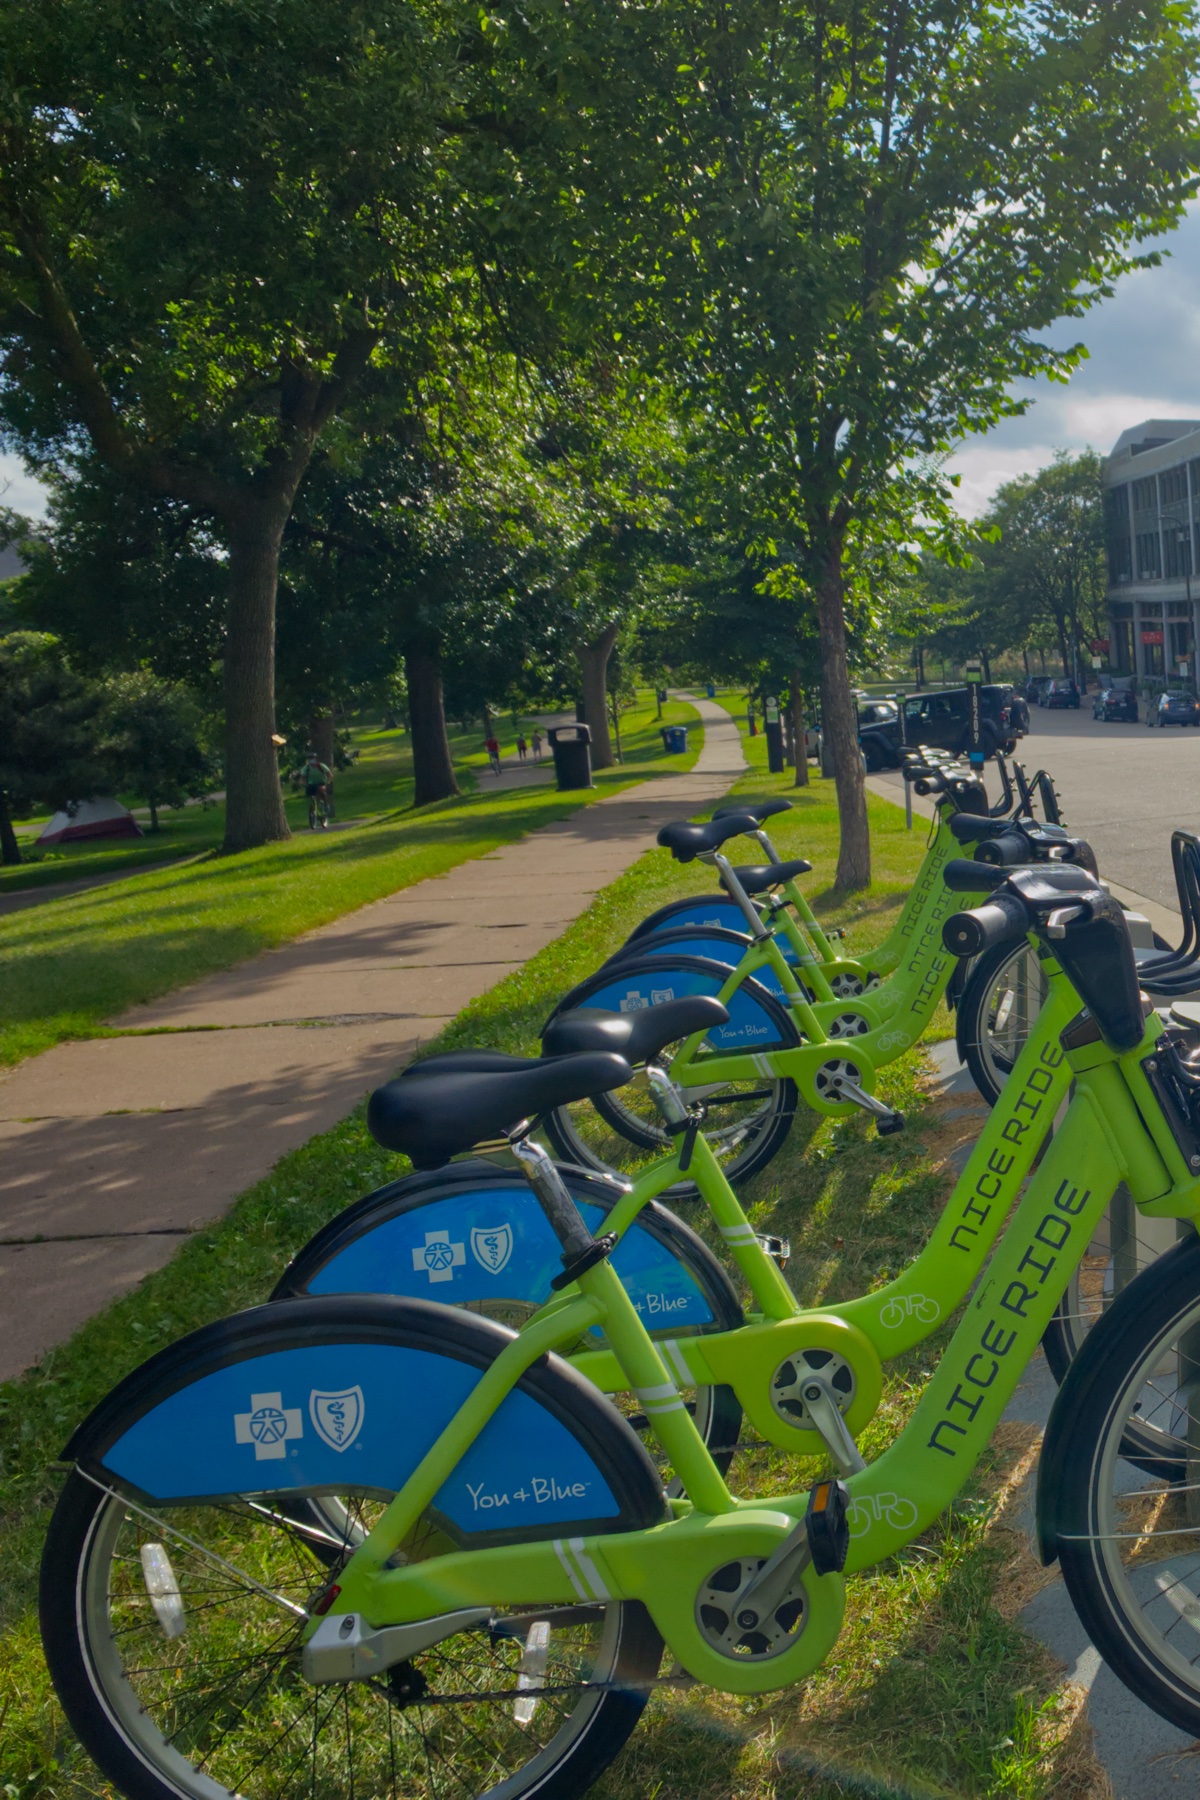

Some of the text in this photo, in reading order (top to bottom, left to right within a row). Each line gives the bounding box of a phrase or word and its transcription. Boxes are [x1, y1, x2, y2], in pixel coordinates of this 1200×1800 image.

[901, 847, 948, 938] NICE RIDE
[911, 956, 947, 1015] NICE
[719, 1026, 738, 1039] You
[745, 1024, 768, 1036] Blue
[948, 1040, 1065, 1253] NICE RIDE
[646, 1293, 688, 1314] Blue
[927, 1179, 1091, 1457] NICE RIDE
[466, 1482, 510, 1511] You
[531, 1477, 586, 1504] Blue
